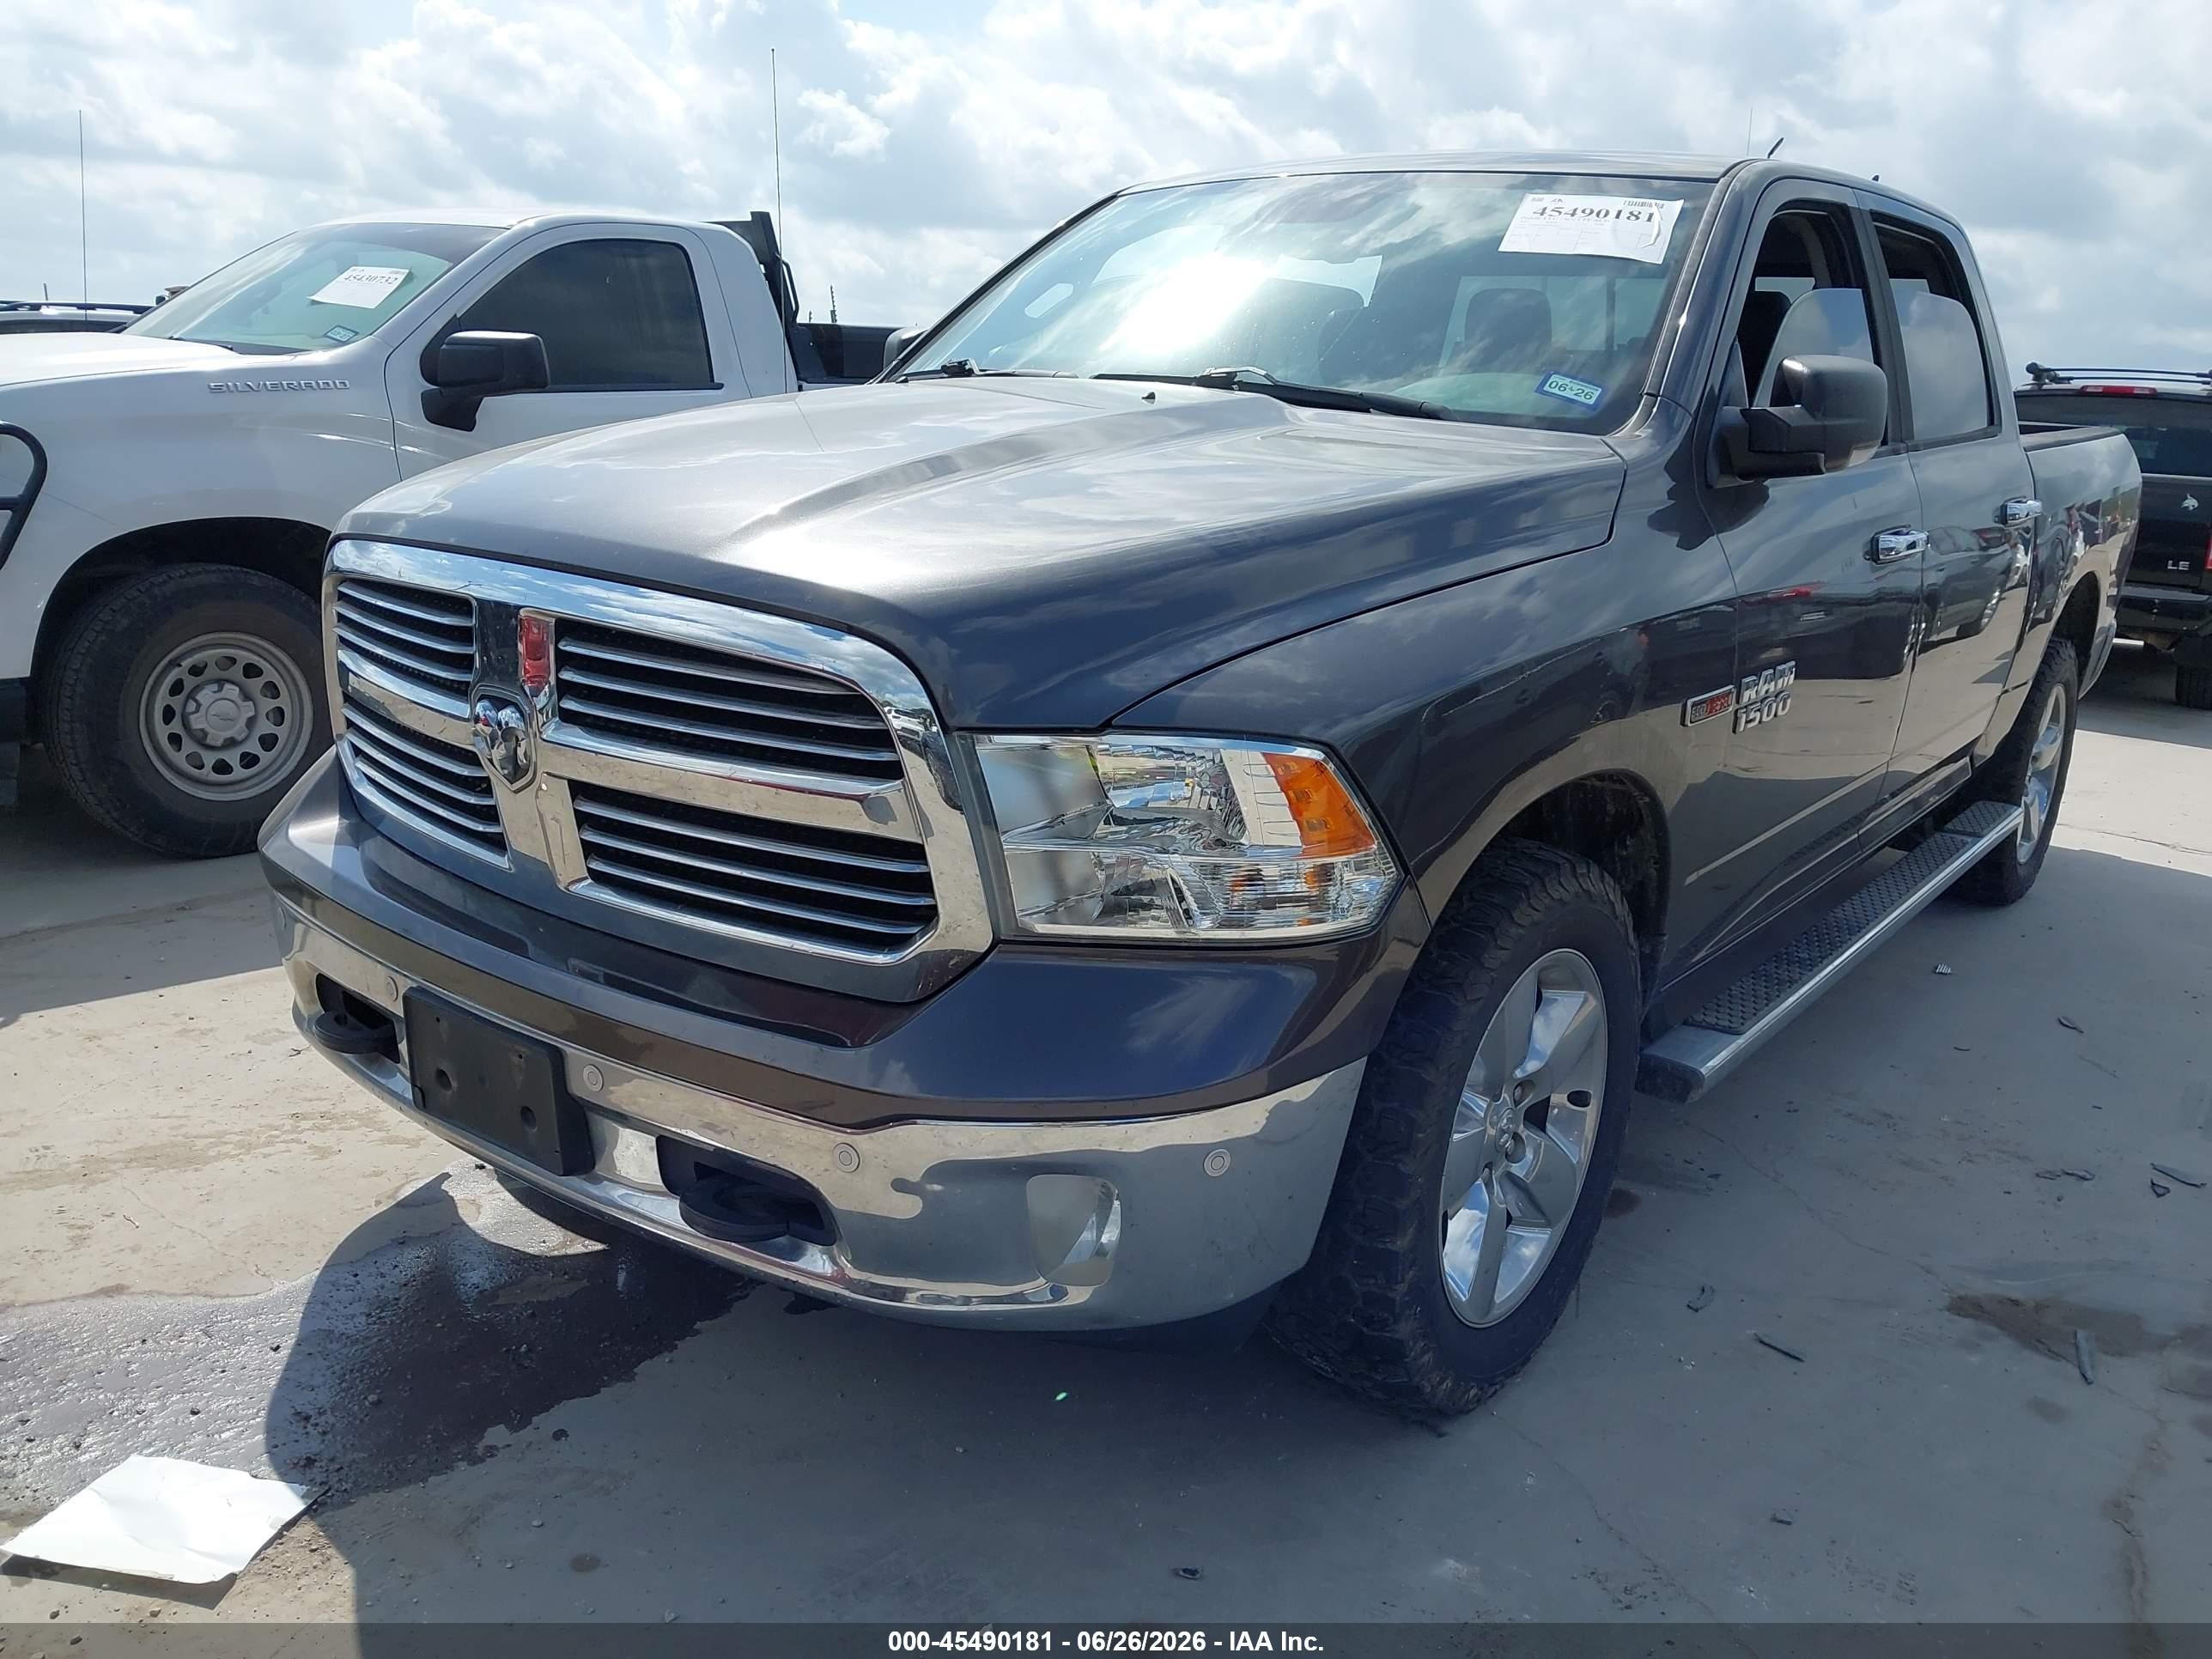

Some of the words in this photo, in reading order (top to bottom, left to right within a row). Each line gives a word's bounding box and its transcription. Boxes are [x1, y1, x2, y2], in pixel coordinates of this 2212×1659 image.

[1532, 205, 1655, 223] 45490181
[209, 380, 350, 393] SILVERADO
[1740, 660, 1796, 704] RAM
[1735, 691, 1792, 732] 1500
